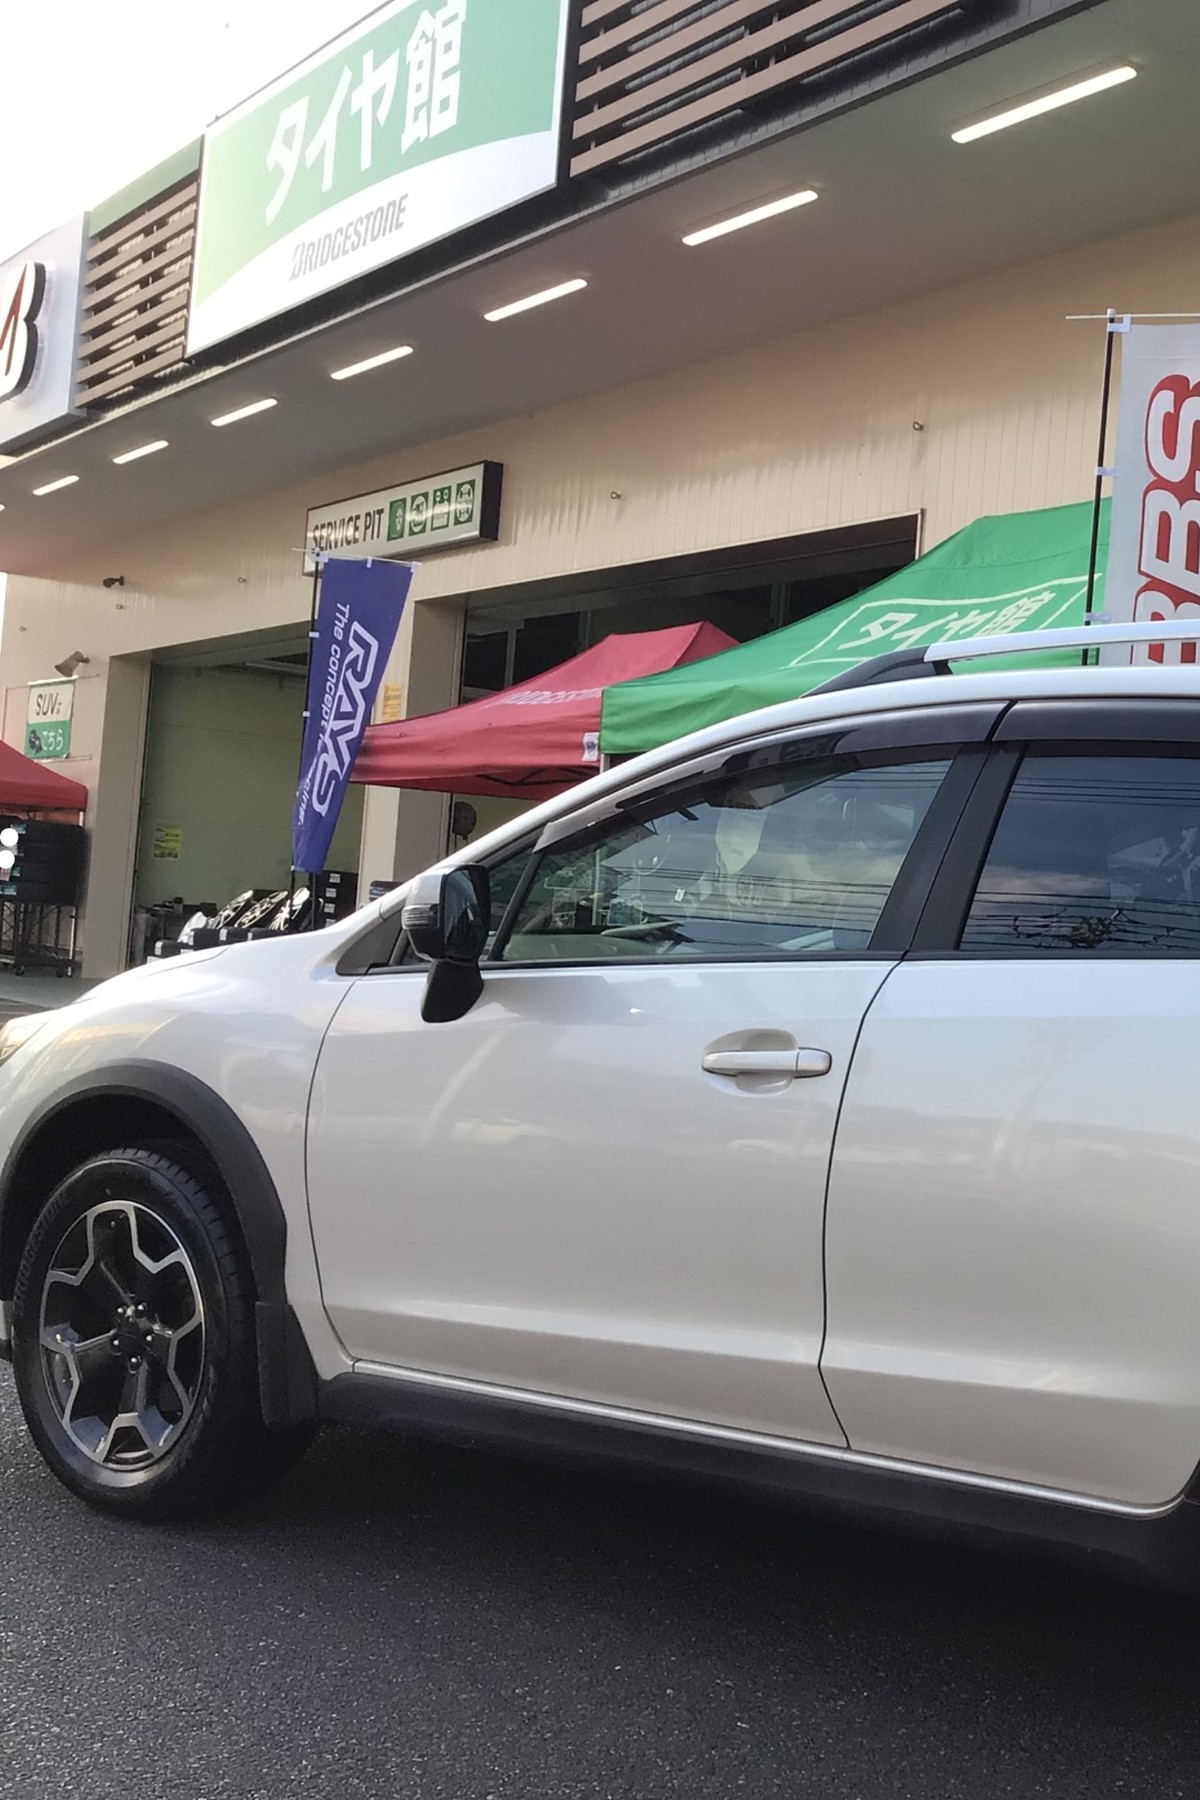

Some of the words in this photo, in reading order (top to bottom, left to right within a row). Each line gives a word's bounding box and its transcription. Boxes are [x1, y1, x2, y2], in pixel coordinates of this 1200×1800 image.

[265, 0, 467, 227] タイヤ館
[289, 193, 409, 282] BRIDGESTONE
[312, 514, 361, 552] SERVICE
[363, 508, 385, 542] PIT
[333, 603, 350, 641] The
[312, 620, 379, 817] RAYS
